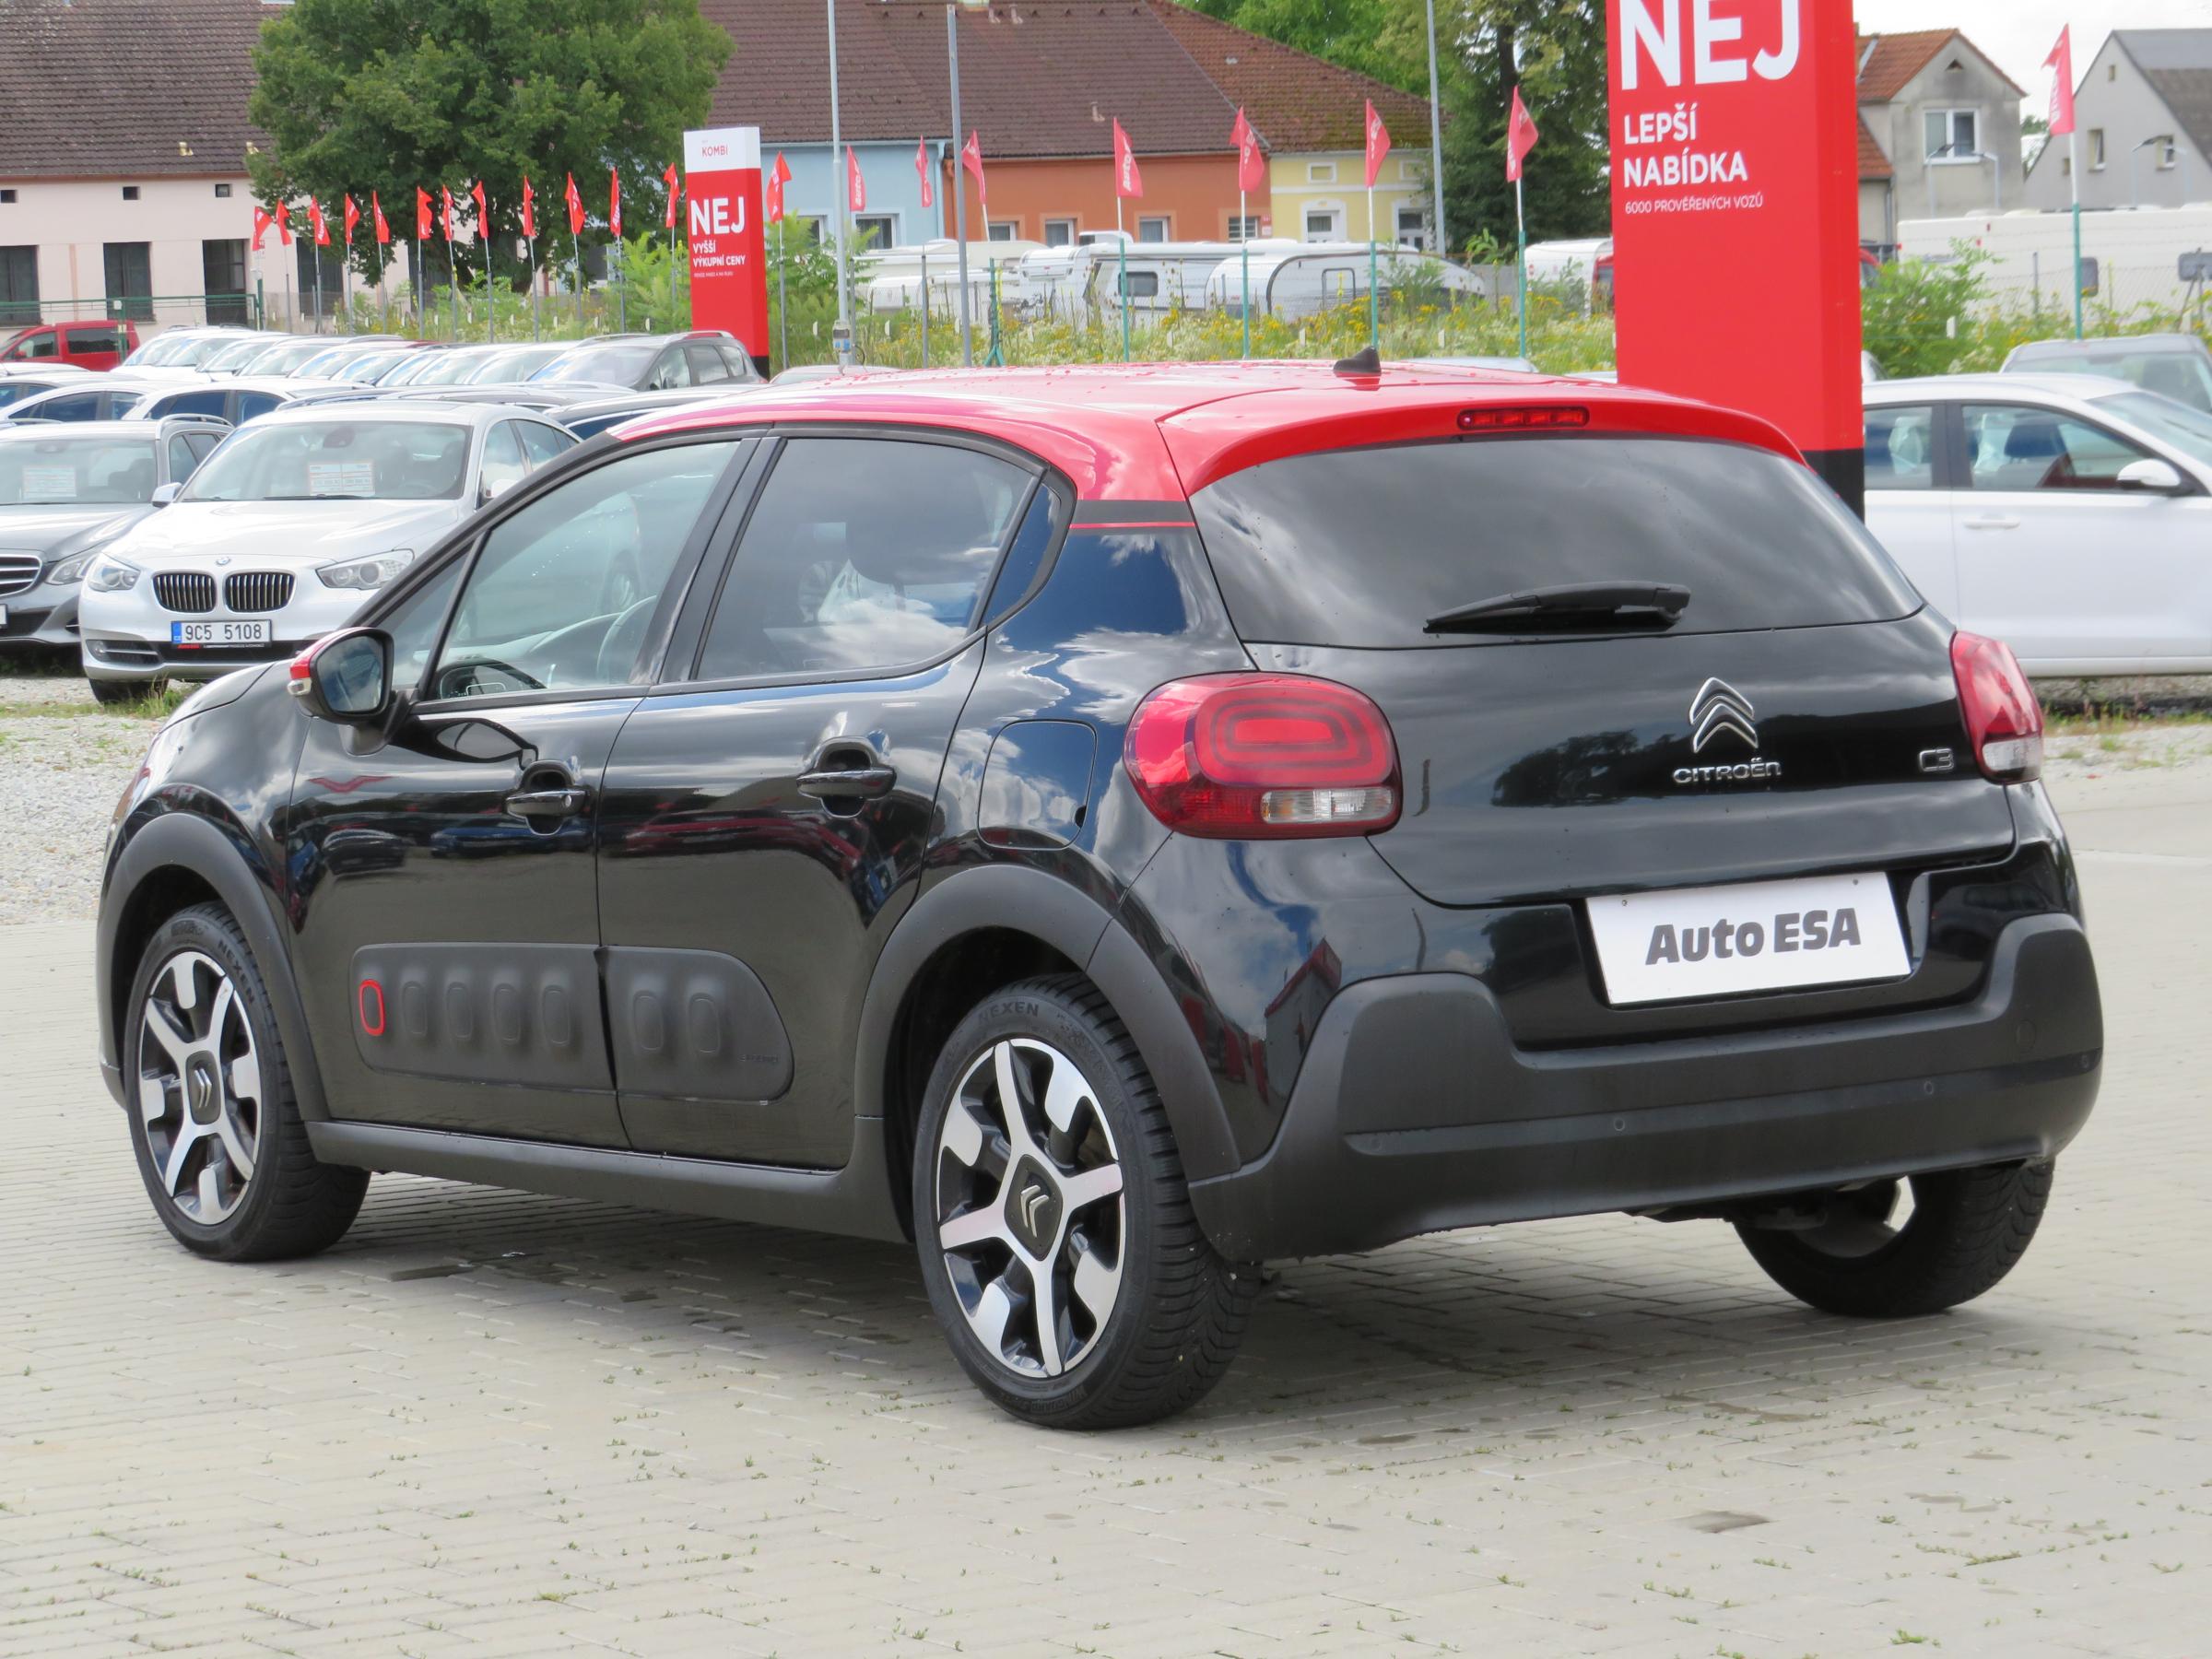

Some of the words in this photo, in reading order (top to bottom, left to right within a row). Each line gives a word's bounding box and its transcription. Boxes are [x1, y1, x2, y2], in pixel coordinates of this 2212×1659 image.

[1619, 0, 1799, 89] NEJ
[1624, 102, 1698, 145] LEPŠÍ
[1623, 147, 1748, 188] NABÍDKA
[690, 196, 745, 236] NEJ
[1625, 201, 1653, 215] 6000
[725, 255, 746, 266] CENY
[184, 625, 213, 641] 9C5
[224, 624, 262, 641] 5108
[1919, 747, 1954, 772] C3
[1645, 919, 1764, 965] Auto
[1774, 908, 1861, 953] ESA
[978, 1000, 1040, 1025] NEXEN
